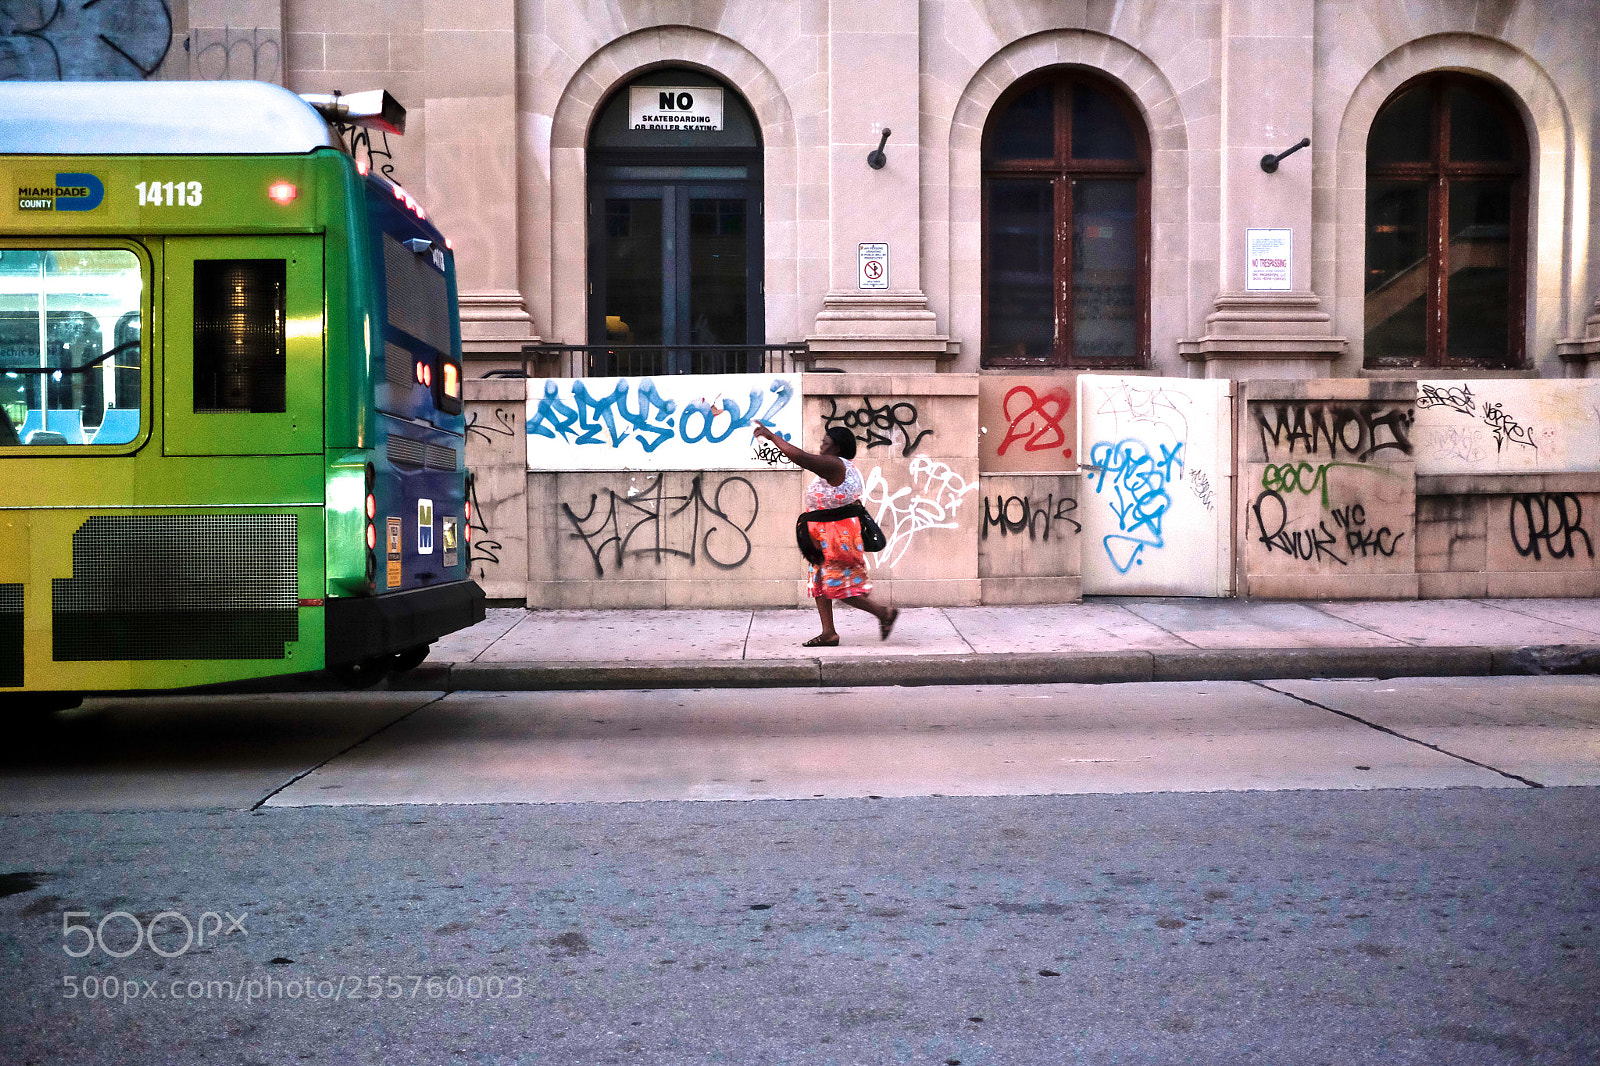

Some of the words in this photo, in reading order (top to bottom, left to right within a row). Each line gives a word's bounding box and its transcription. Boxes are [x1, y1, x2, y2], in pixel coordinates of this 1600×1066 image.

[659, 92, 694, 110] NO
[642, 115, 711, 123] SKATEBOARDING
[135, 181, 203, 207] 14113
[19, 199, 52, 208] COUNTY
